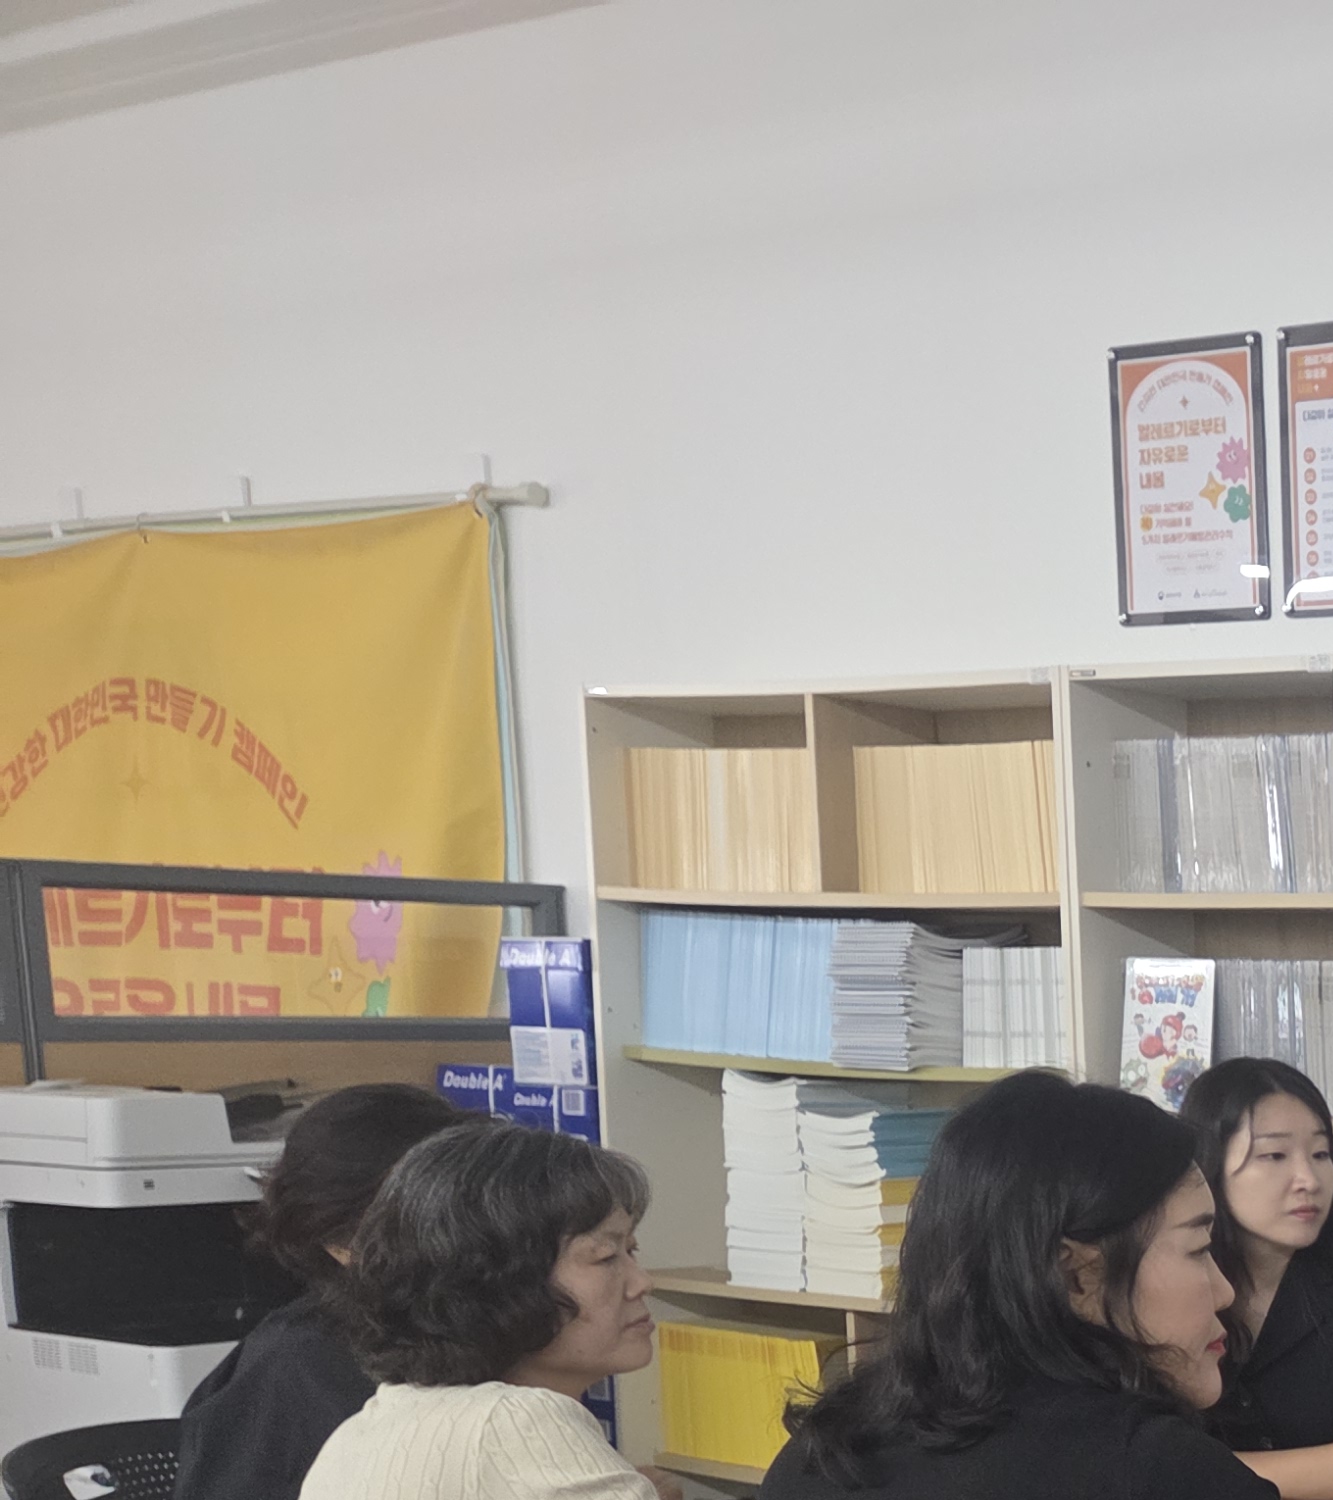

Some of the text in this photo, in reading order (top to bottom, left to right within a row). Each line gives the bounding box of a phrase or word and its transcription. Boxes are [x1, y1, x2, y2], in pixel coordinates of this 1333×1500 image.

[1137, 416, 1226, 442] 알레르기로부터
[1138, 445, 1189, 466] 자유로운
[1139, 471, 1165, 490] 내몸
[47, 676, 139, 753] 대한민국
[144, 677, 227, 748] 만들기
[230, 717, 310, 831] 캠페인
[442, 1069, 504, 1091] Double A
